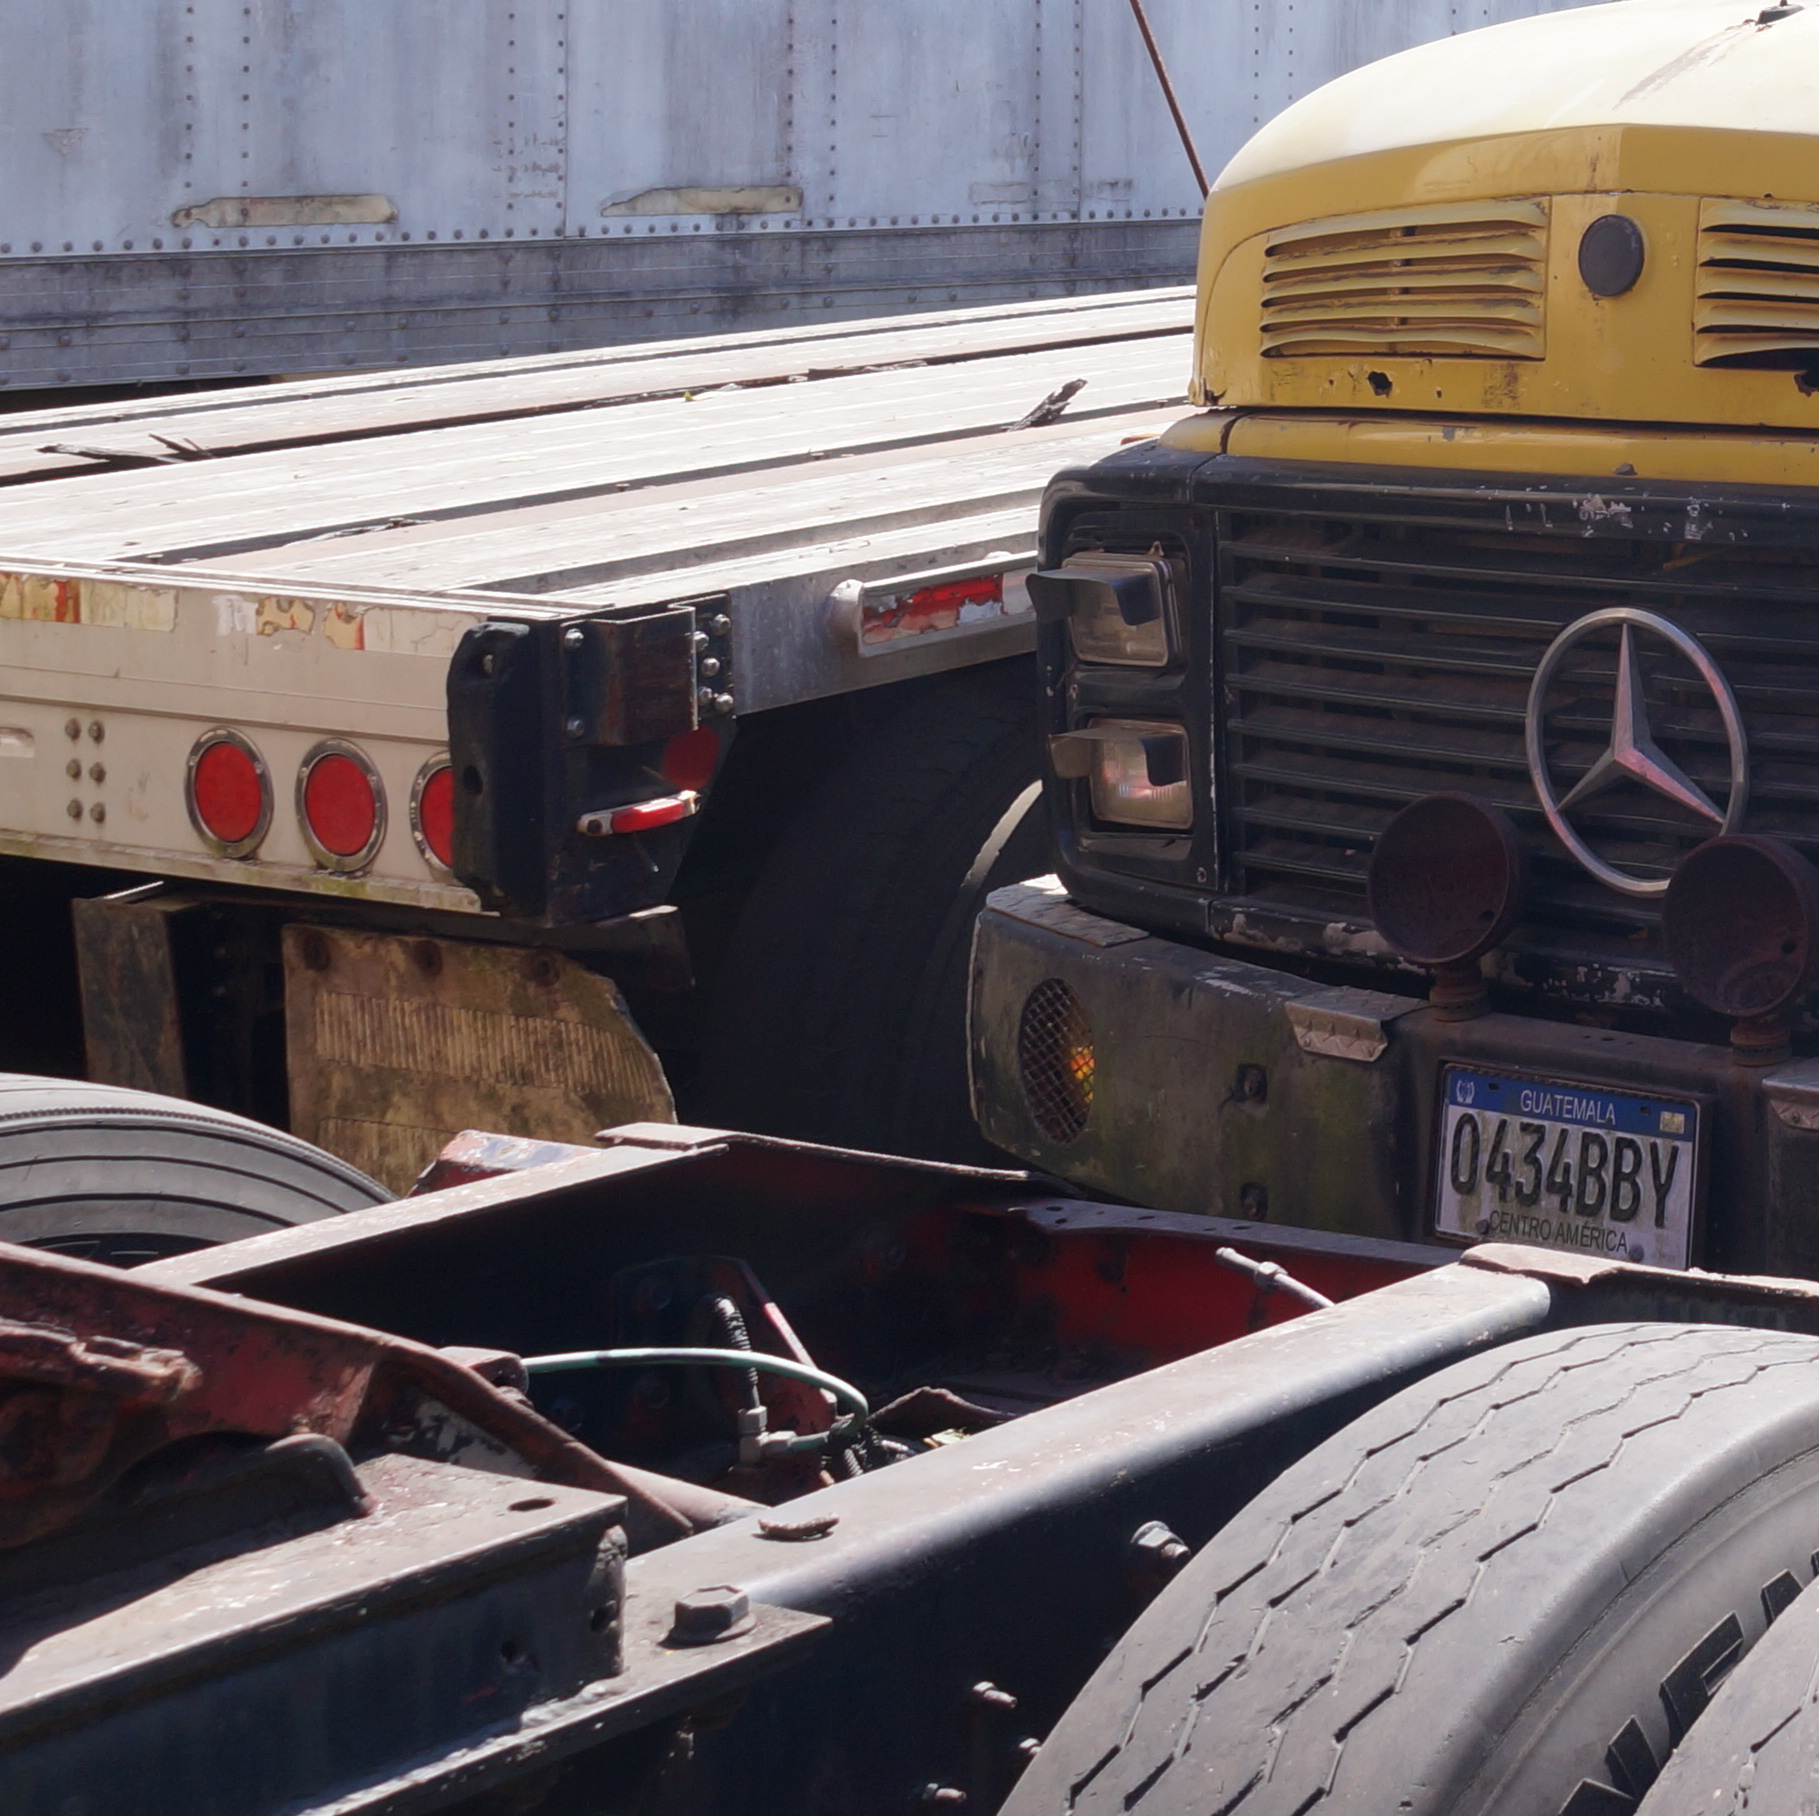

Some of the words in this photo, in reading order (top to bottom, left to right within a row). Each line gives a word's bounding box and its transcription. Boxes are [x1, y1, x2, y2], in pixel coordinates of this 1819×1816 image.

[1520, 1089, 1616, 1125] GUATEMALA
[1489, 1210, 1550, 1242] CENTRO
[1555, 1220, 1628, 1254] AMÉRICA
